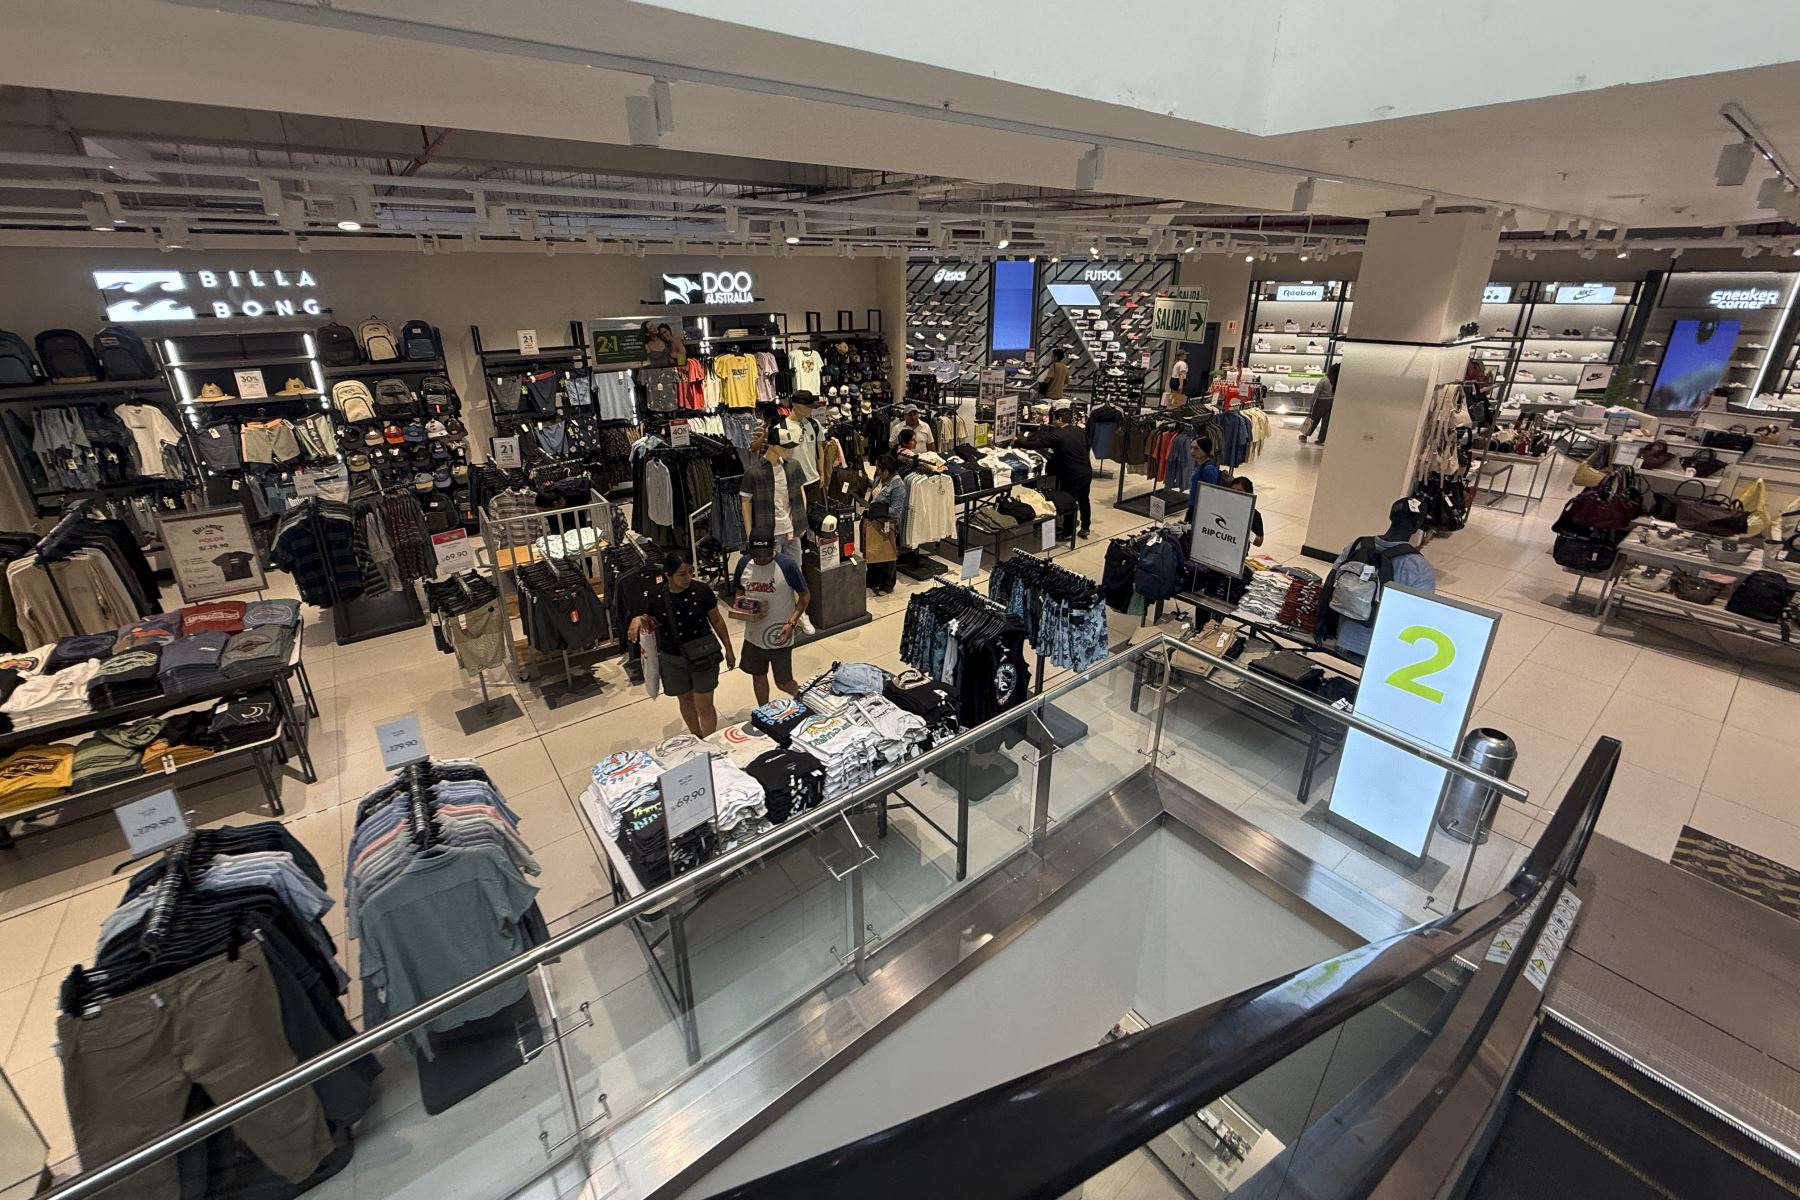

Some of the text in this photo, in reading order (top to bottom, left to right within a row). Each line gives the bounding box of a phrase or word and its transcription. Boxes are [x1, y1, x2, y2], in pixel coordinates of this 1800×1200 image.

[199, 270, 316, 288] BILLA
[702, 271, 752, 293] DOO
[1085, 270, 1122, 281] FUTBOL
[705, 292, 754, 305] AUSTRALIA
[1283, 289, 1318, 297] Reebok
[212, 299, 320, 318] BONG
[1155, 308, 1187, 331] SALIDA
[240, 375, 259, 383] 30%
[1201, 526, 1237, 544] RIP CURL
[1384, 625, 1456, 705] 2
